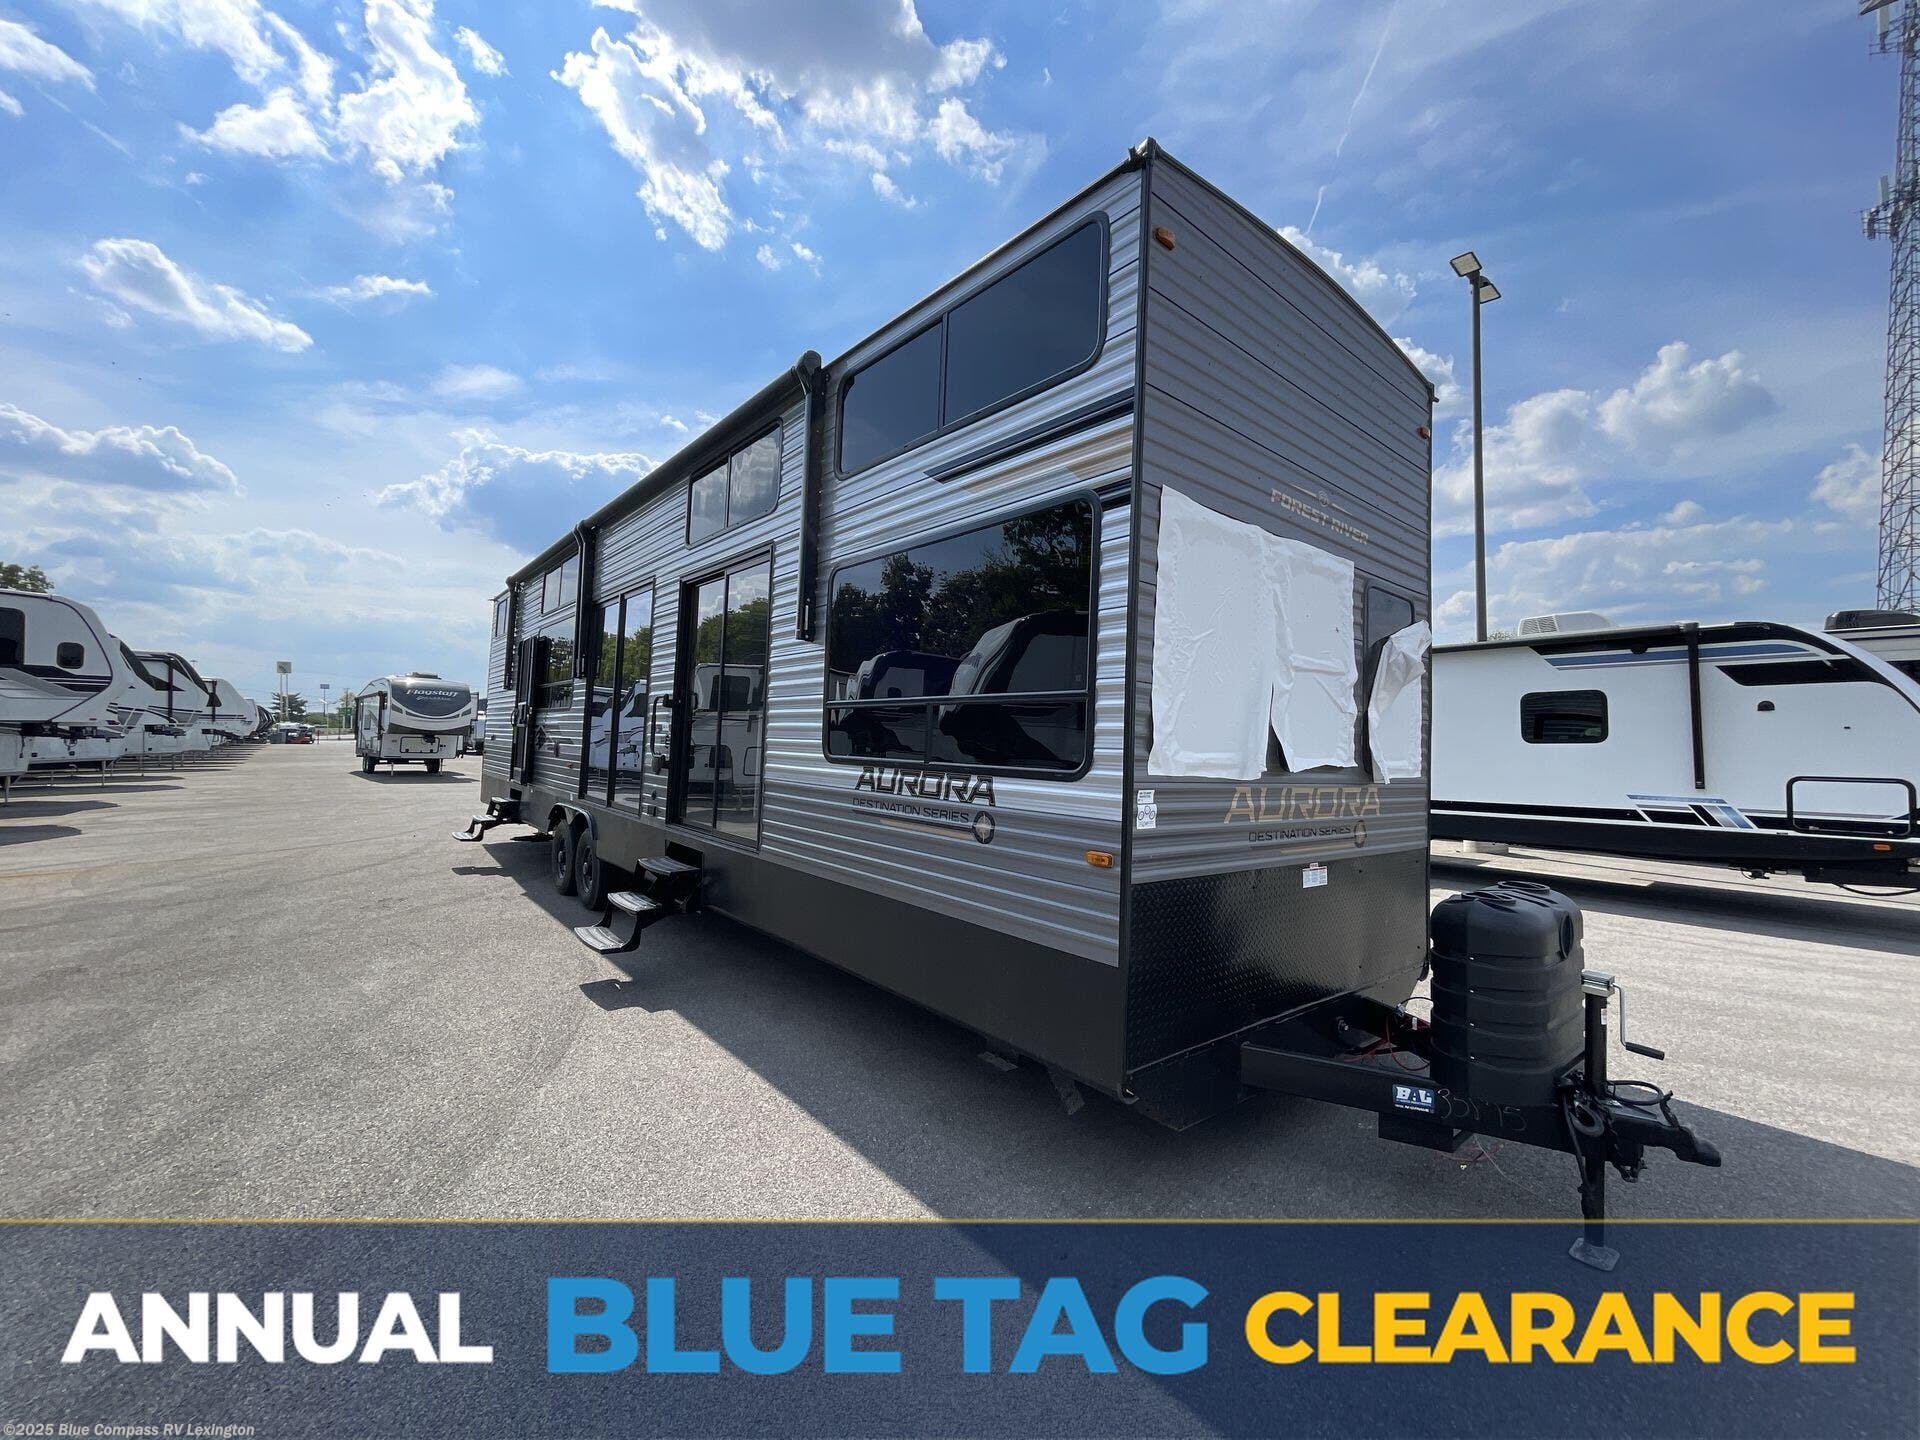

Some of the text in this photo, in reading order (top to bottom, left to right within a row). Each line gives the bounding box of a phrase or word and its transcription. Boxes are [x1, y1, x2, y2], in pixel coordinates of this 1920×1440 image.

[1271, 488, 1369, 545] FOREST RIVER
[406, 689, 458, 697] Flagstaff
[855, 766, 996, 806] AURORA
[852, 797, 970, 823] DESTINATION SERIES
[1223, 787, 1381, 824] AURORA
[1248, 826, 1351, 842] DESTINATION SERIES
